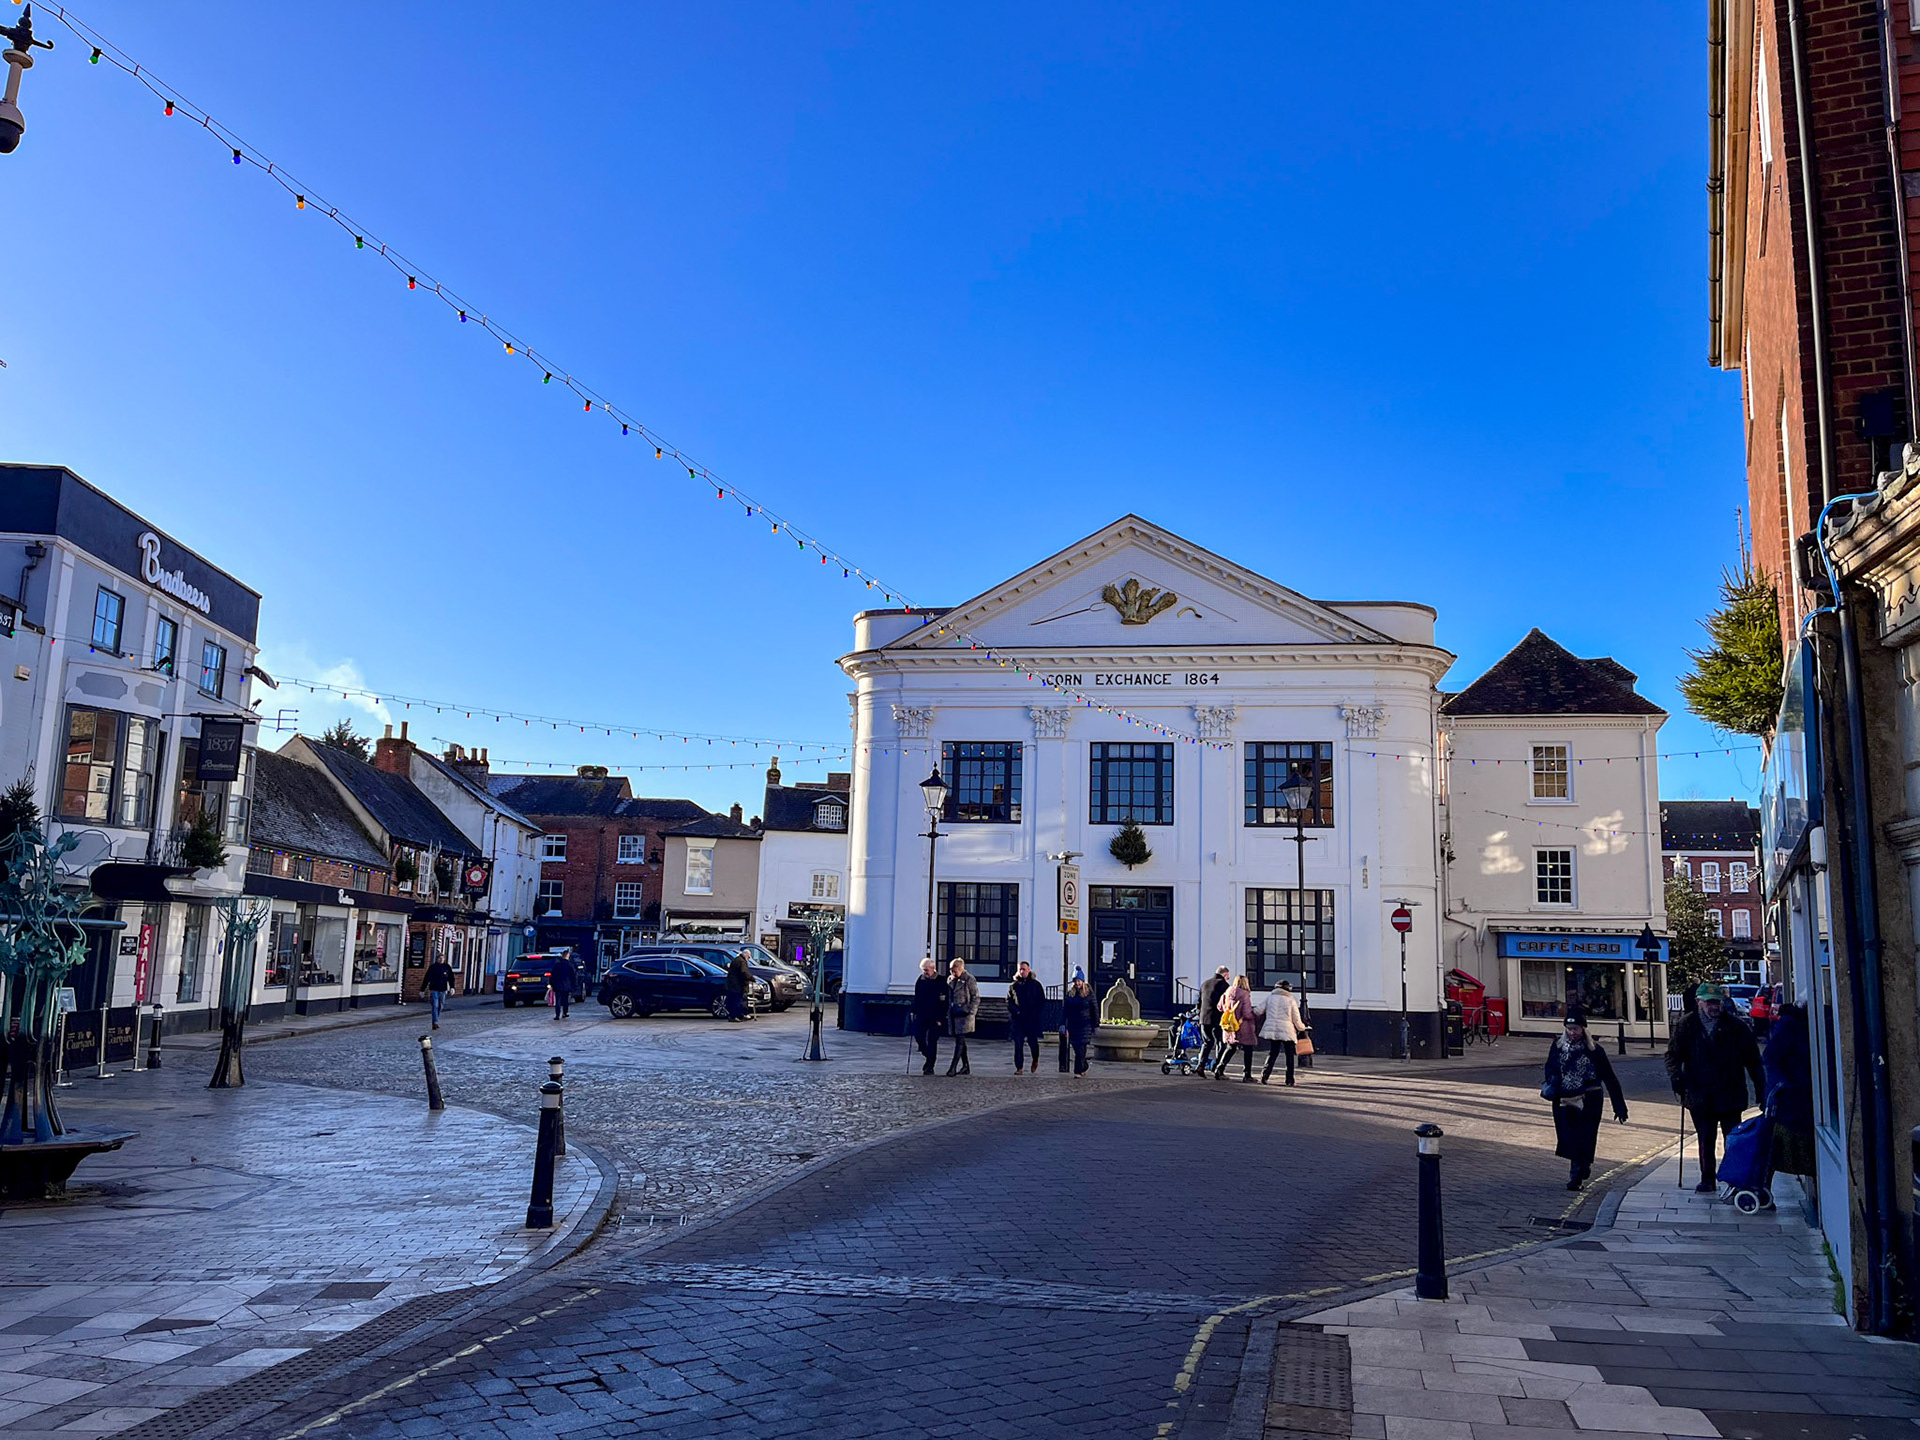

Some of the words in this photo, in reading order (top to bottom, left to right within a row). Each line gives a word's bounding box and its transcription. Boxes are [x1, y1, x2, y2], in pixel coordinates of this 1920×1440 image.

[137, 531, 212, 615] Bradbeers
[1046, 673, 1082, 686] CORN
[1185, 673, 1220, 685] 1864
[206, 738, 236, 752] 1837
[1063, 871, 1076, 880] ZONE
[1573, 942, 1621, 954] NERO
[138, 929, 151, 996] SALE
